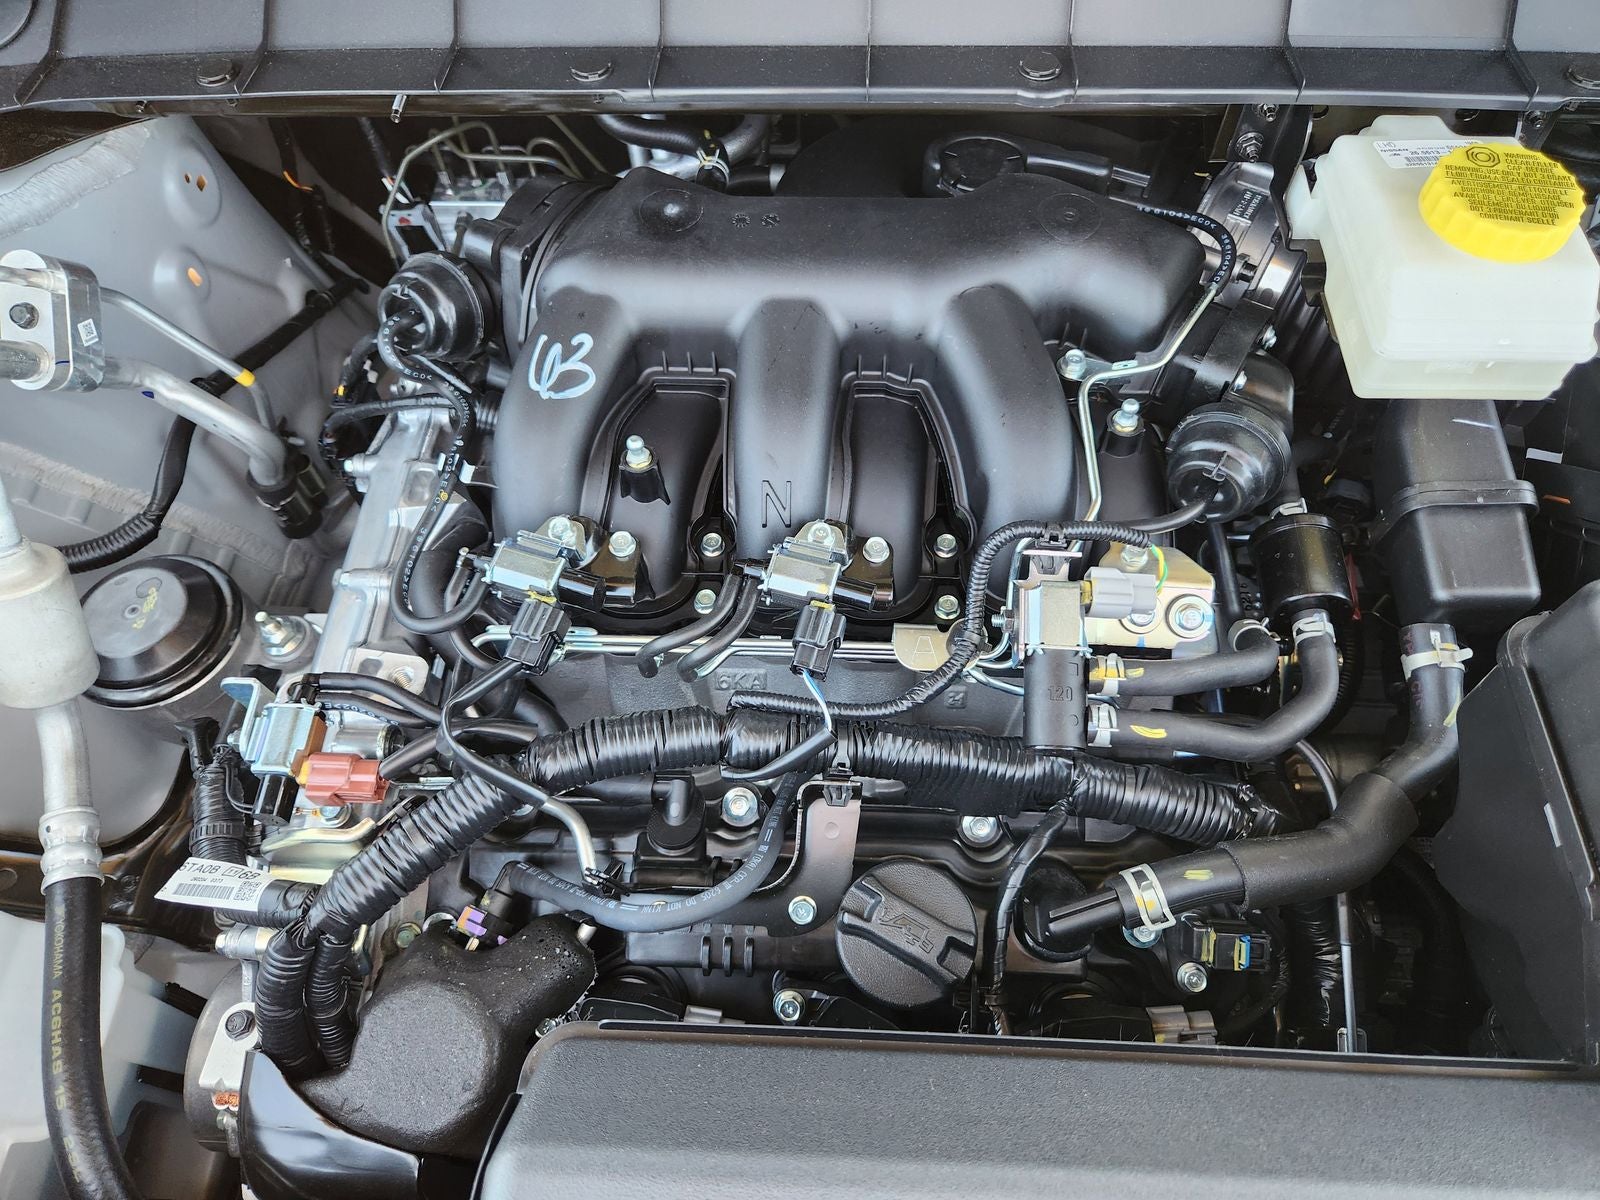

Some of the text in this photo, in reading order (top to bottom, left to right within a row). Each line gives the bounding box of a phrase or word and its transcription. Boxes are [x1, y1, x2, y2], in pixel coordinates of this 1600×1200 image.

[761, 479, 792, 528] N
[910, 635, 938, 665] A
[53, 914, 66, 979] YOKOHAMA
